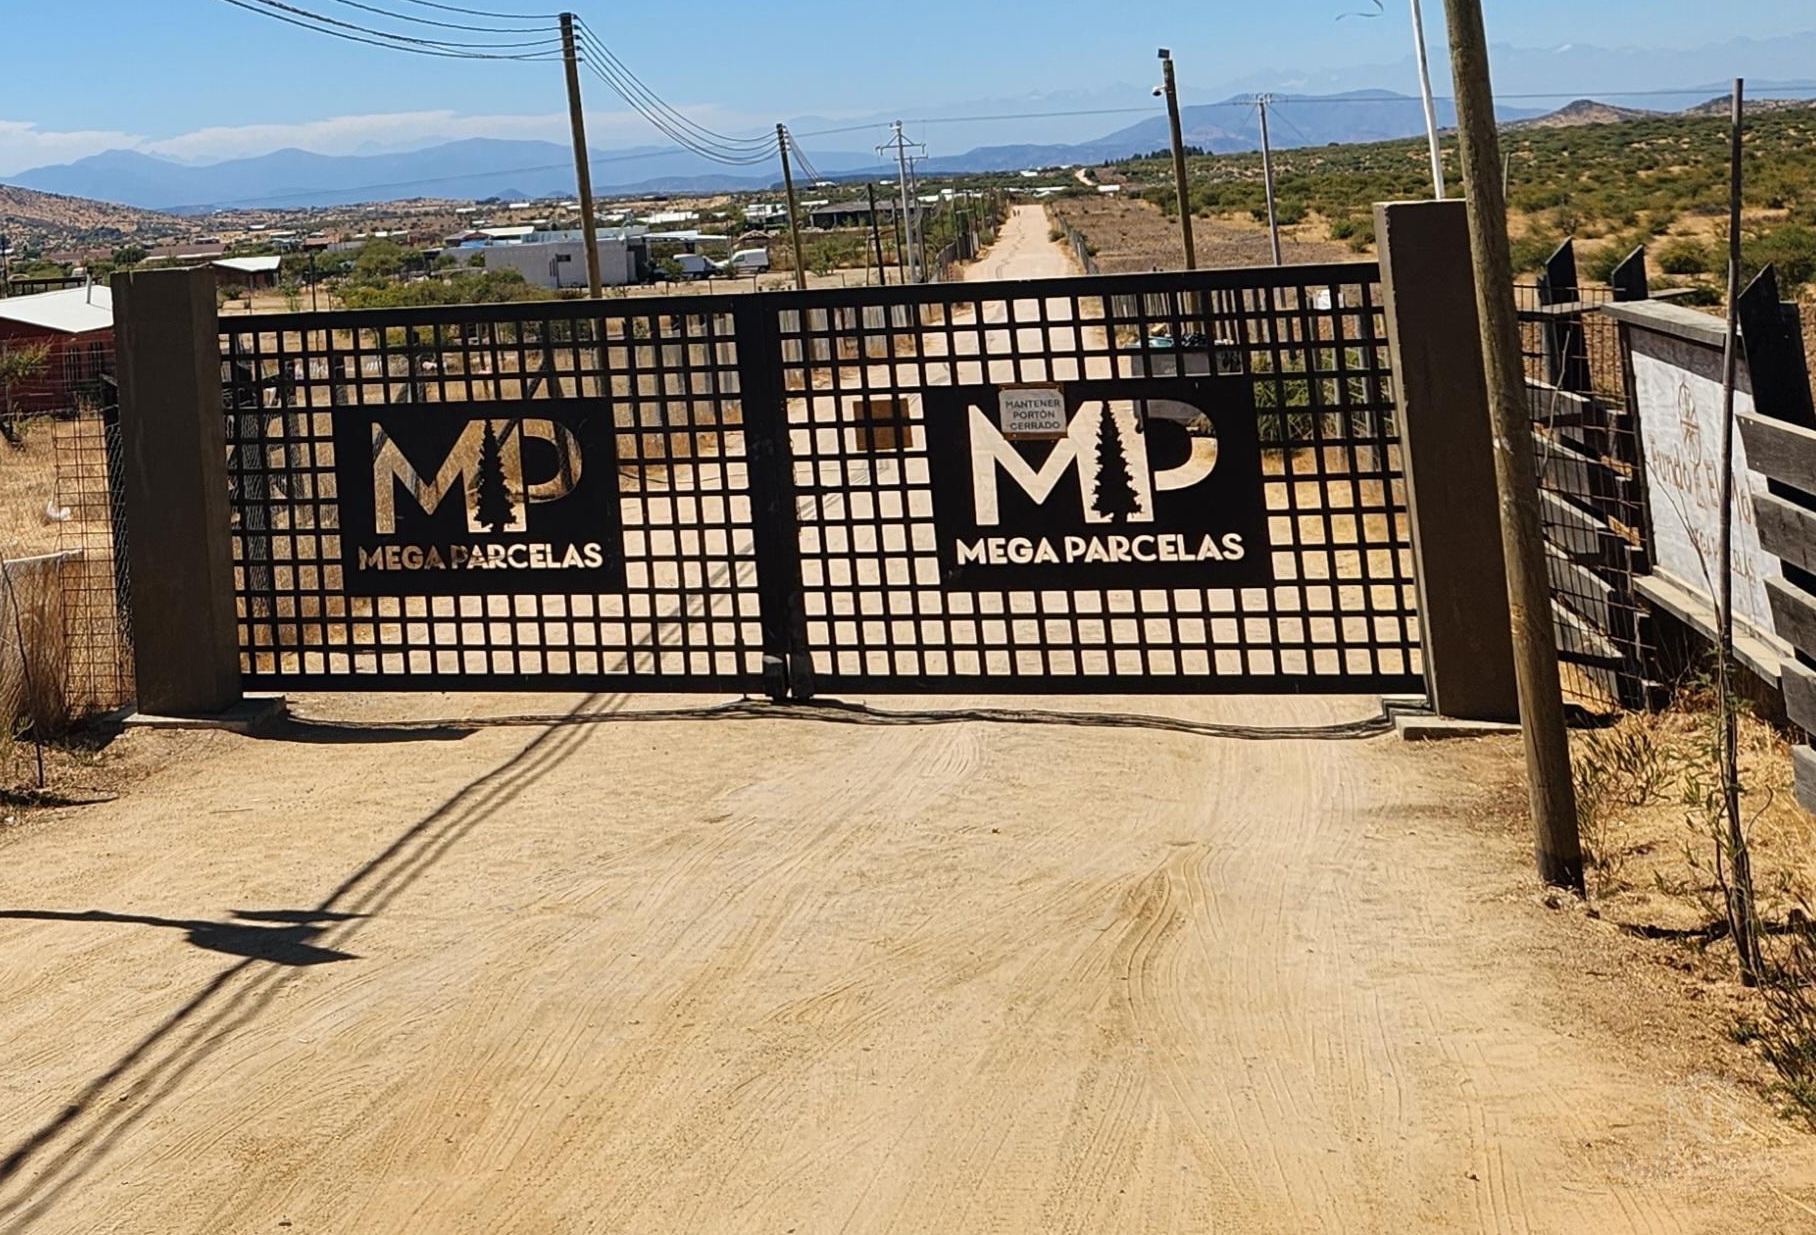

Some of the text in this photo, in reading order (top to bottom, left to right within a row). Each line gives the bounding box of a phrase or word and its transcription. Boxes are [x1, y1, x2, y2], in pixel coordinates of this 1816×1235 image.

[1005, 398, 1061, 409] MANTENER
[1013, 409, 1055, 419] PORTÓN
[1010, 421, 1061, 431] CERRADO
[371, 418, 582, 534] MP
[968, 399, 1218, 526] MP
[358, 542, 604, 570] MEGA PARCELAS
[956, 532, 1245, 565] MEGA PARCELAS
